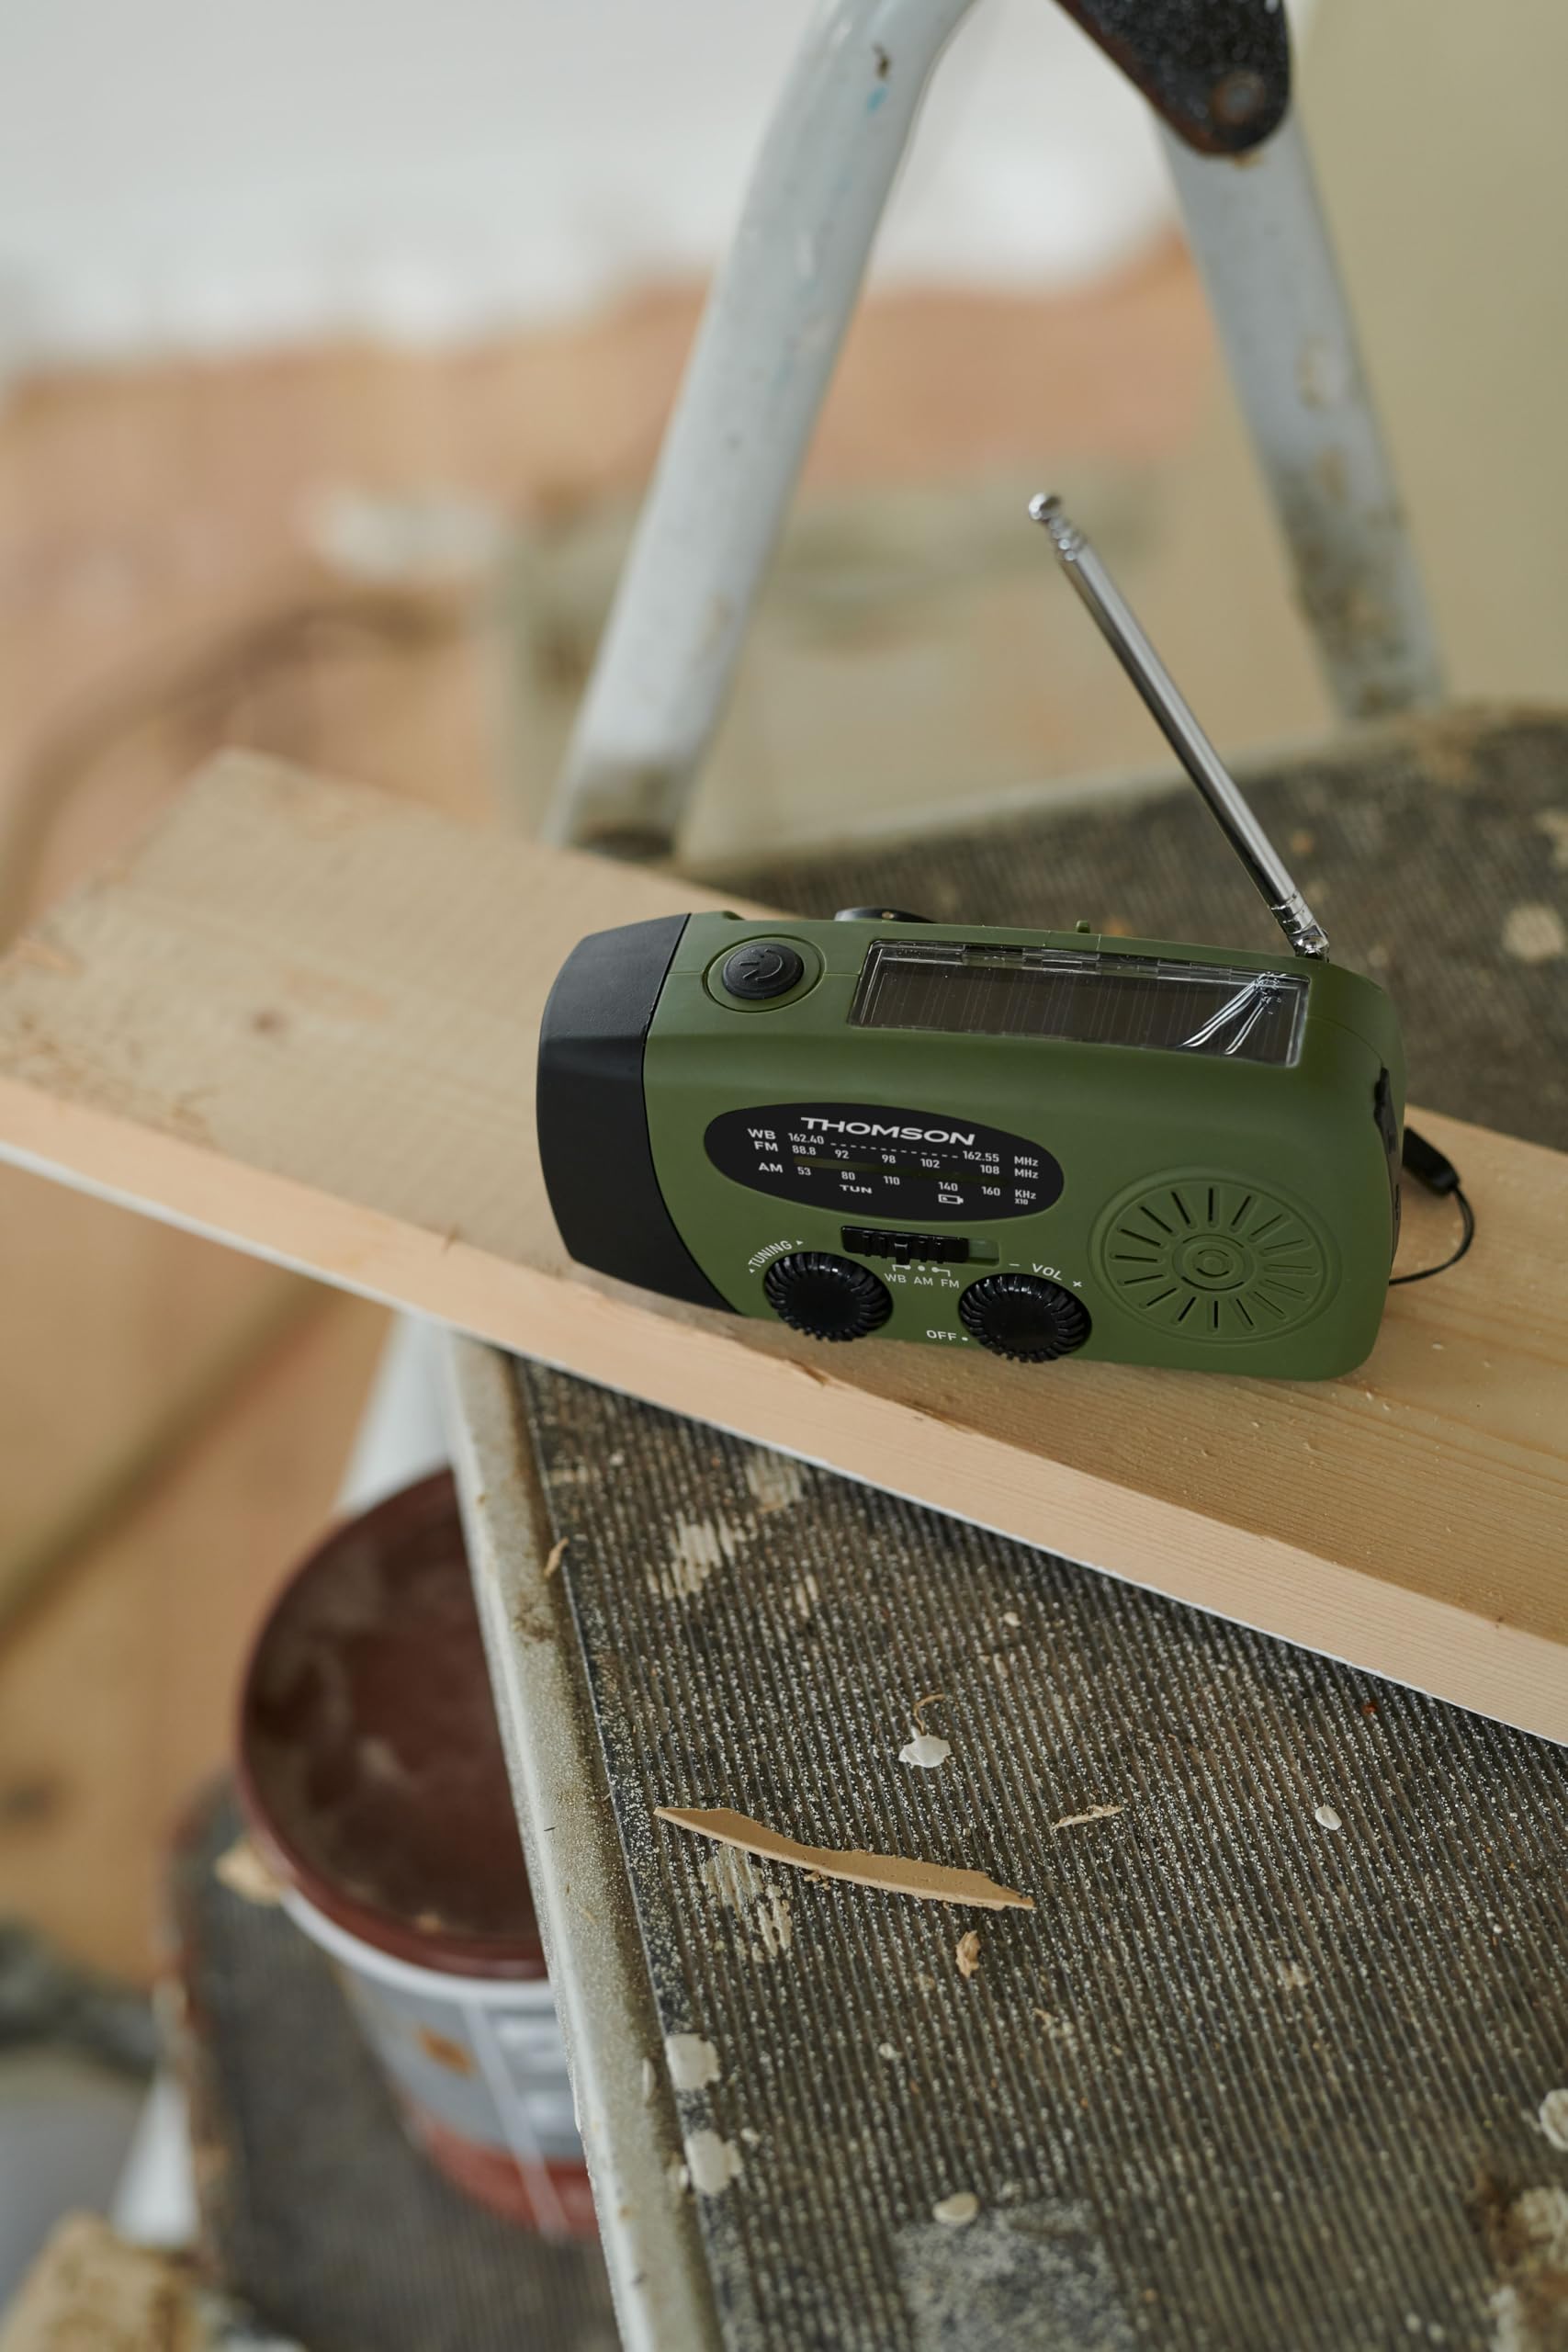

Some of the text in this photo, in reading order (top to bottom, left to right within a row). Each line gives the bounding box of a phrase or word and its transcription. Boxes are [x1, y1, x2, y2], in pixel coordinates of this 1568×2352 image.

[801, 1116, 976, 1146] THOMSON
[747, 1128, 1038, 1166] WB 162.40 162.55 MHz
[753, 1140, 1038, 1179] FM 88.8 92 98 102 108 MHz
[757, 1162, 1036, 1199] AM 53 80 110 140 160 KHz
[840, 1184, 873, 1194] TUN
[748, 1240, 794, 1269] TUNING
[884, 1272, 961, 1289] WB AM FM
[1032, 1262, 1063, 1281] VOL
[926, 1329, 957, 1341] OFF
